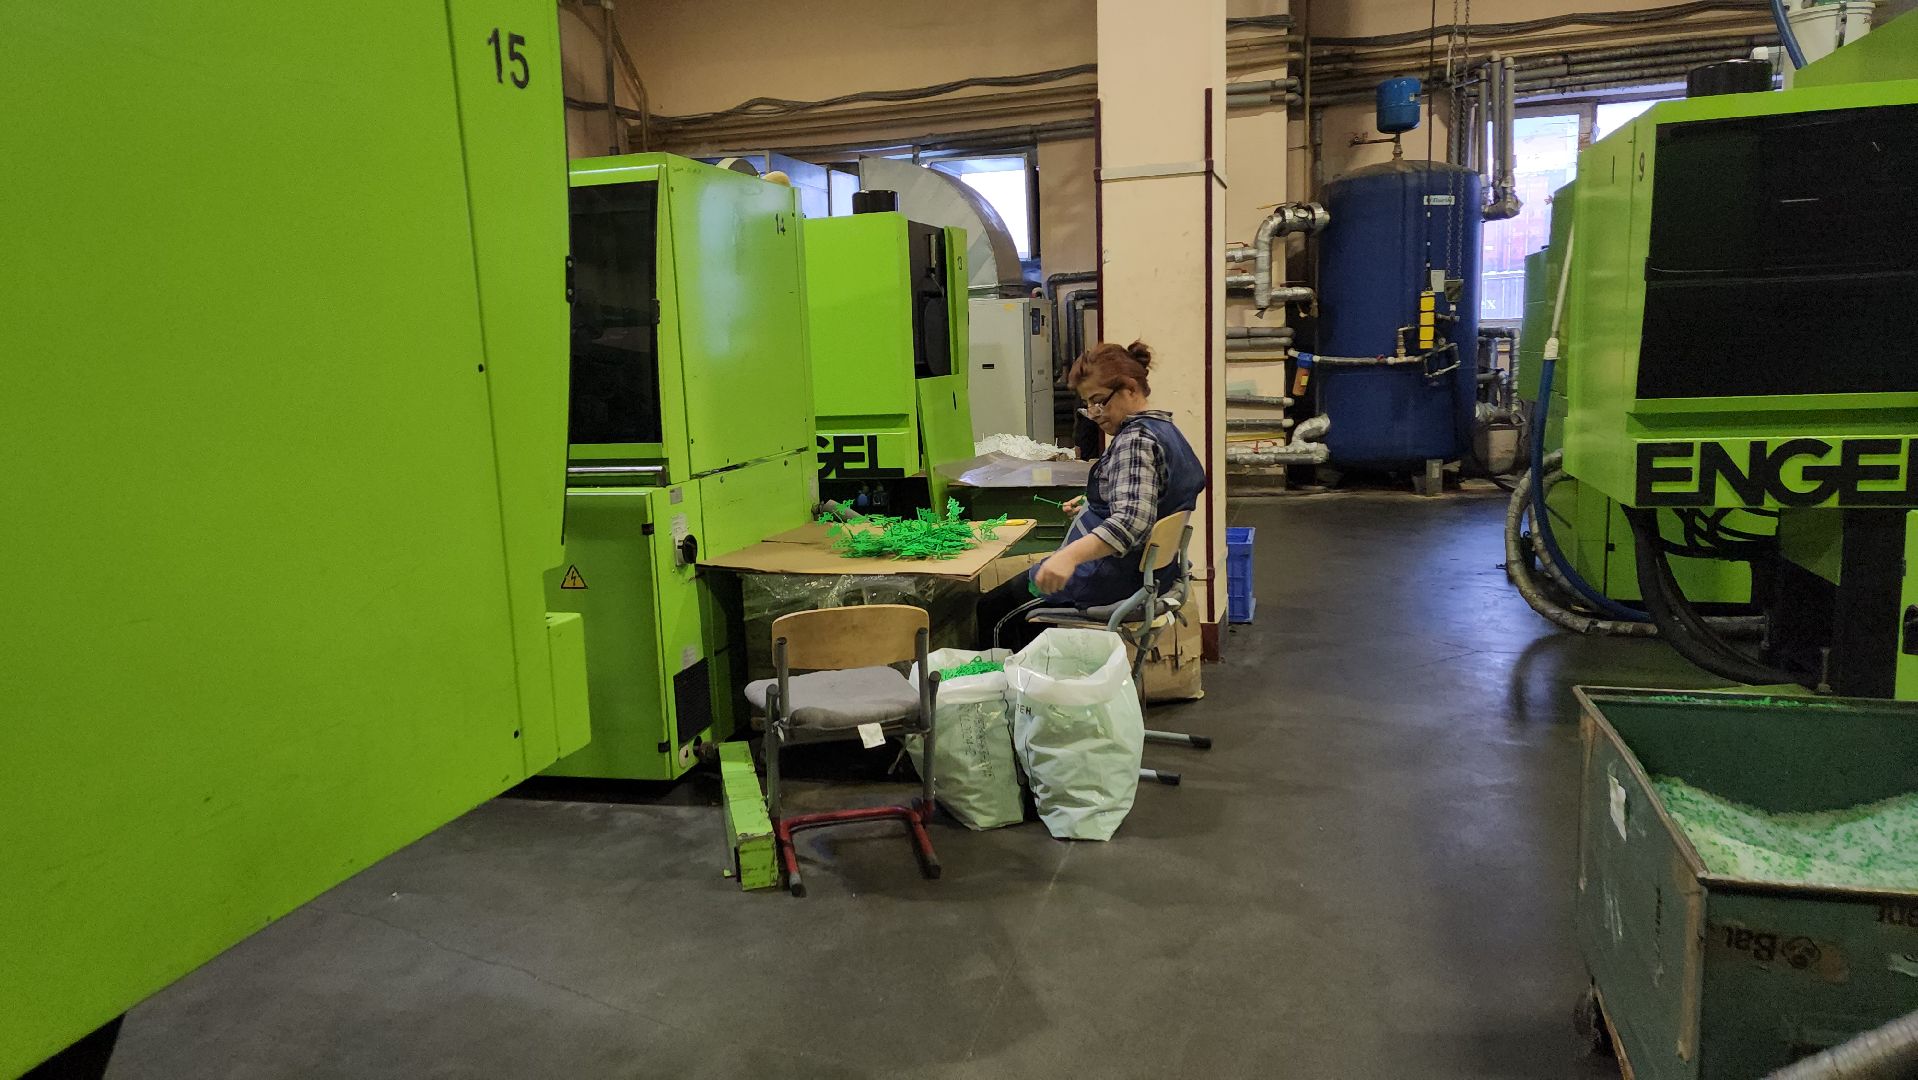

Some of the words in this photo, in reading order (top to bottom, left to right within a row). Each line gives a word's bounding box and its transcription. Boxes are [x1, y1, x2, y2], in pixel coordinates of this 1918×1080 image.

[488, 27, 530, 89] 15
[775, 213, 786, 236] 14
[1635, 438, 1918, 507] ENGE
